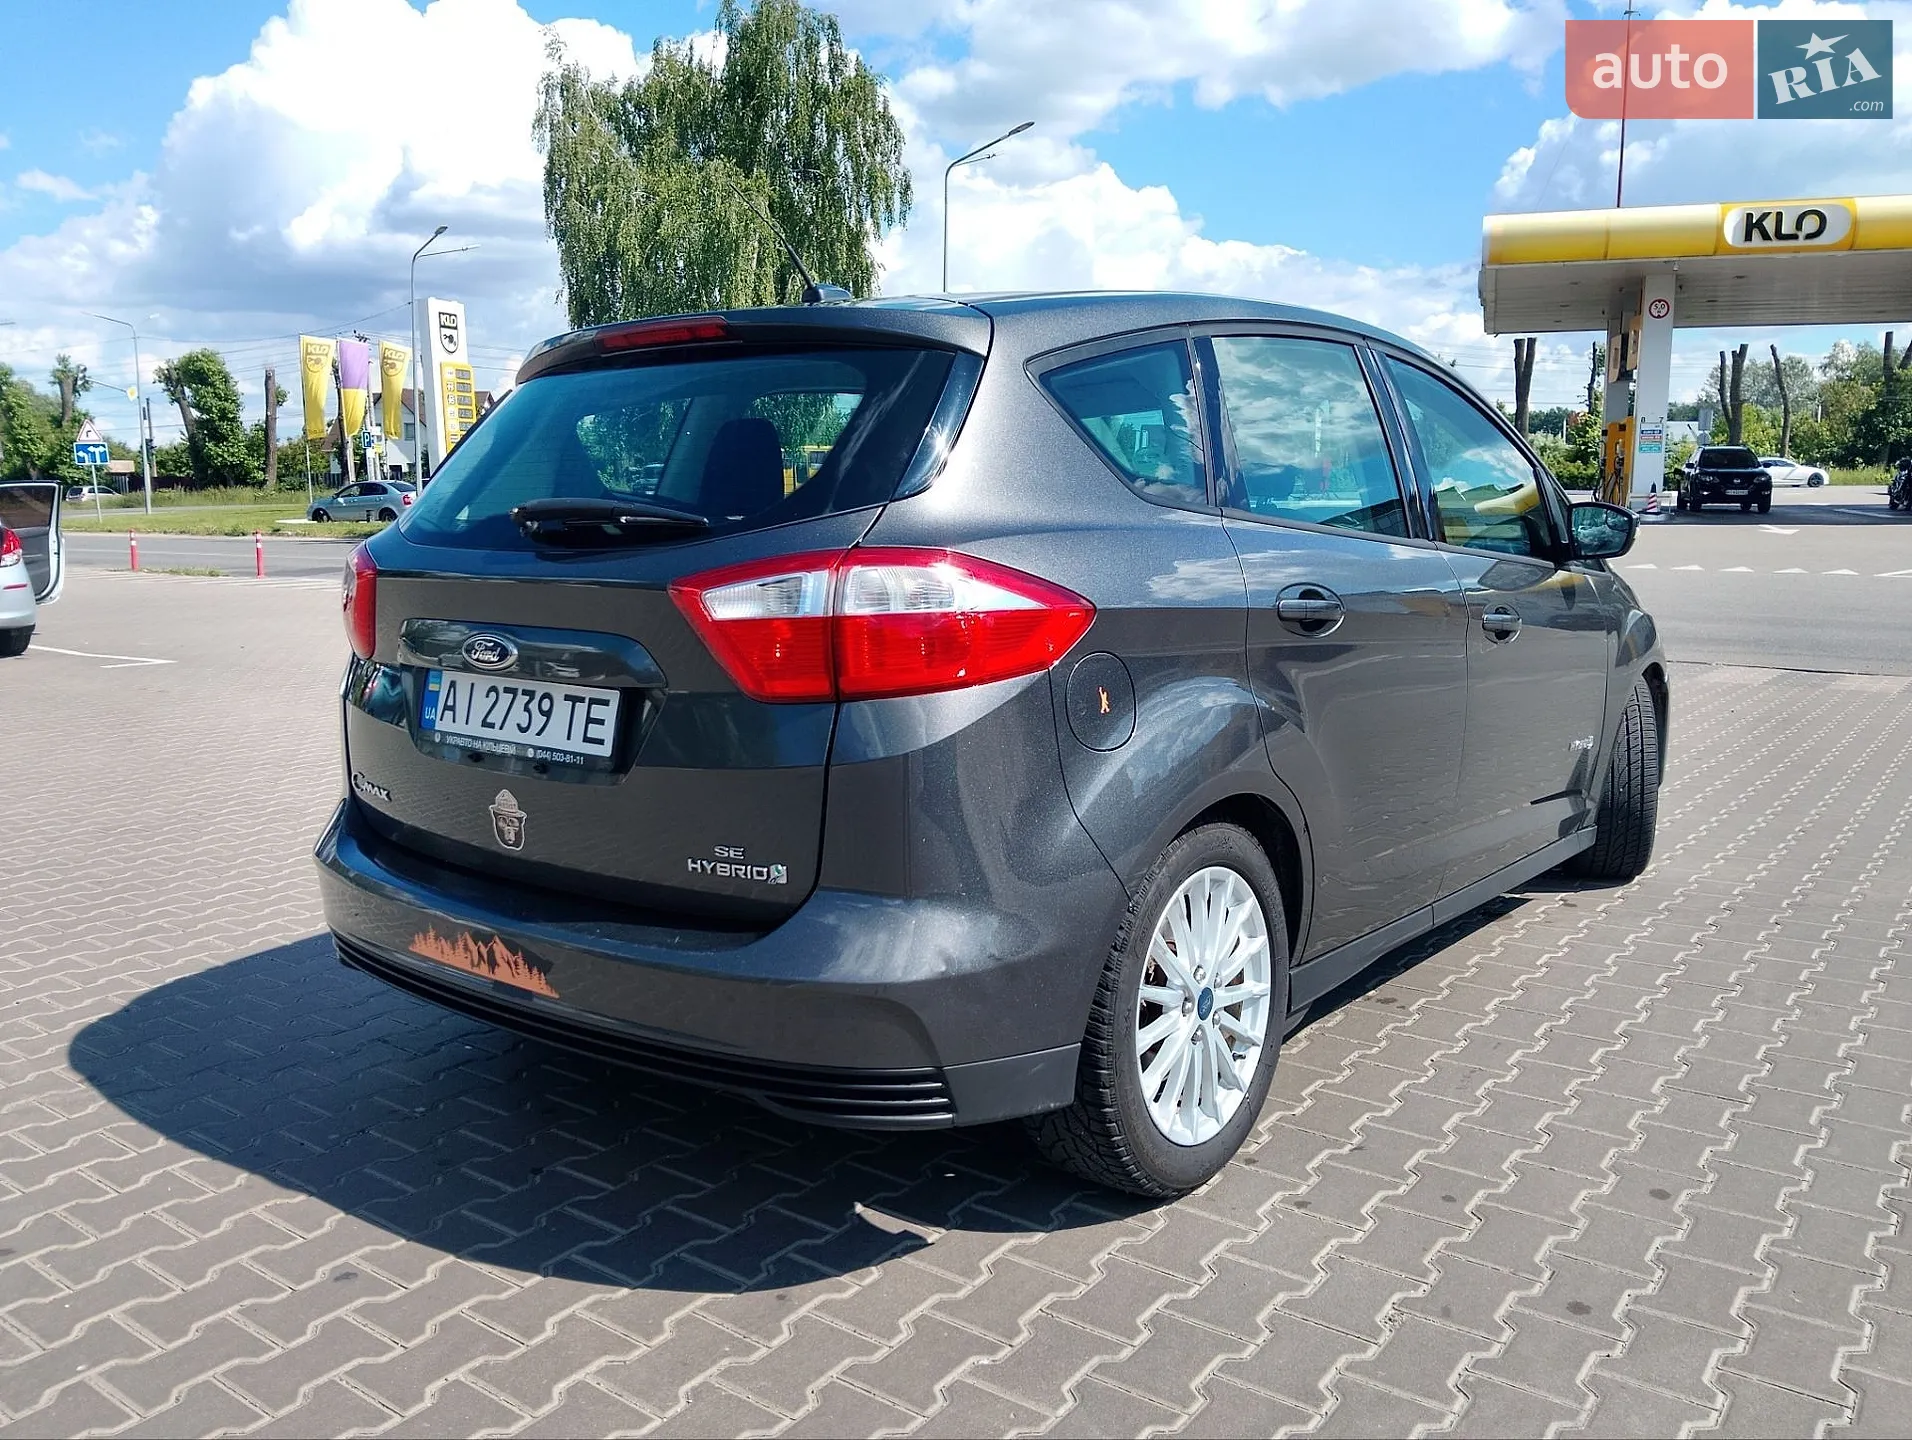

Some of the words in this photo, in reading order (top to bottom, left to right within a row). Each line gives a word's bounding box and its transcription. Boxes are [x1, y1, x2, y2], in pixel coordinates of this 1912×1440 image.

[1743, 208, 1828, 243] KLO
[440, 313, 457, 327] KLO
[307, 344, 329, 354] KLO
[384, 348, 405, 359] KLO
[471, 640, 500, 662] Ford
[424, 706, 436, 721] UA
[480, 685, 555, 737] 2739
[563, 693, 611, 746] TE
[714, 845, 745, 860] SE
[687, 858, 768, 880] HYBRID
